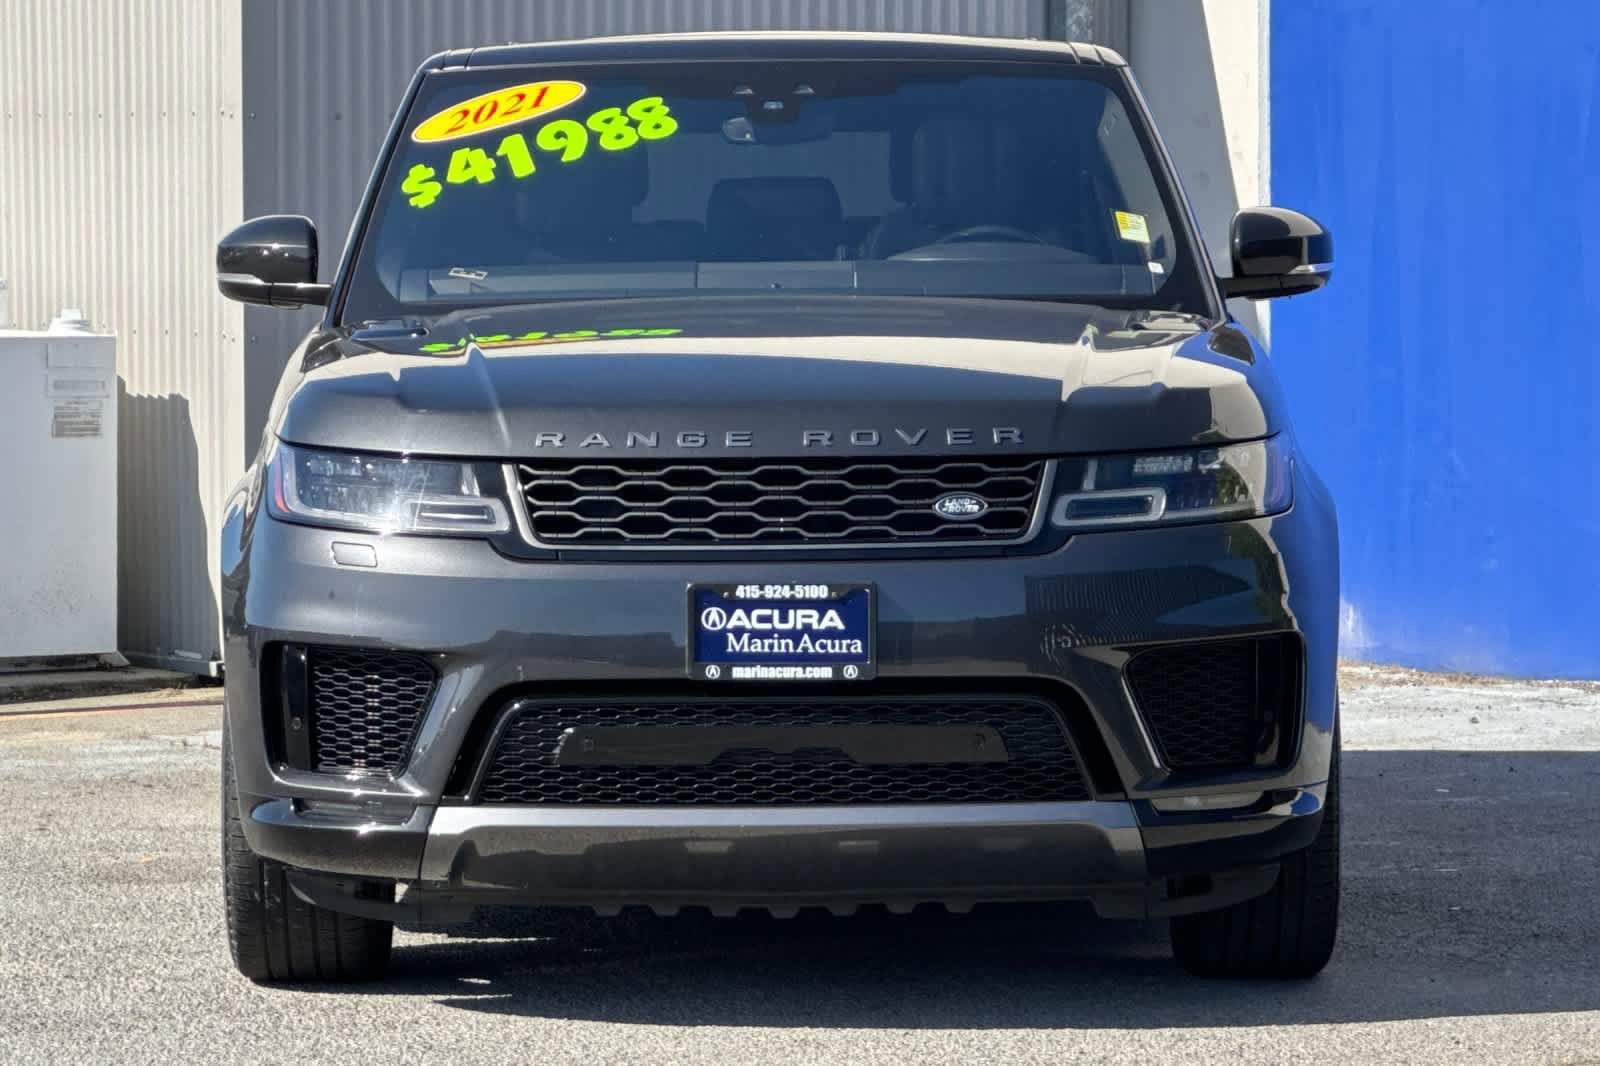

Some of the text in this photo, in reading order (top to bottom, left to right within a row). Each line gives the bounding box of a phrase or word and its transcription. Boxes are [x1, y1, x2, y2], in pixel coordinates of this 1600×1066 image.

[445, 86, 549, 135] 2021
[401, 97, 678, 208] $41988
[535, 427, 1024, 449] RANGE ROVER
[735, 585, 828, 598] 415-924-5100
[726, 609, 845, 629] ACURA
[726, 633, 863, 653] Marin Acura
[732, 666, 832, 679] marinacura.com
